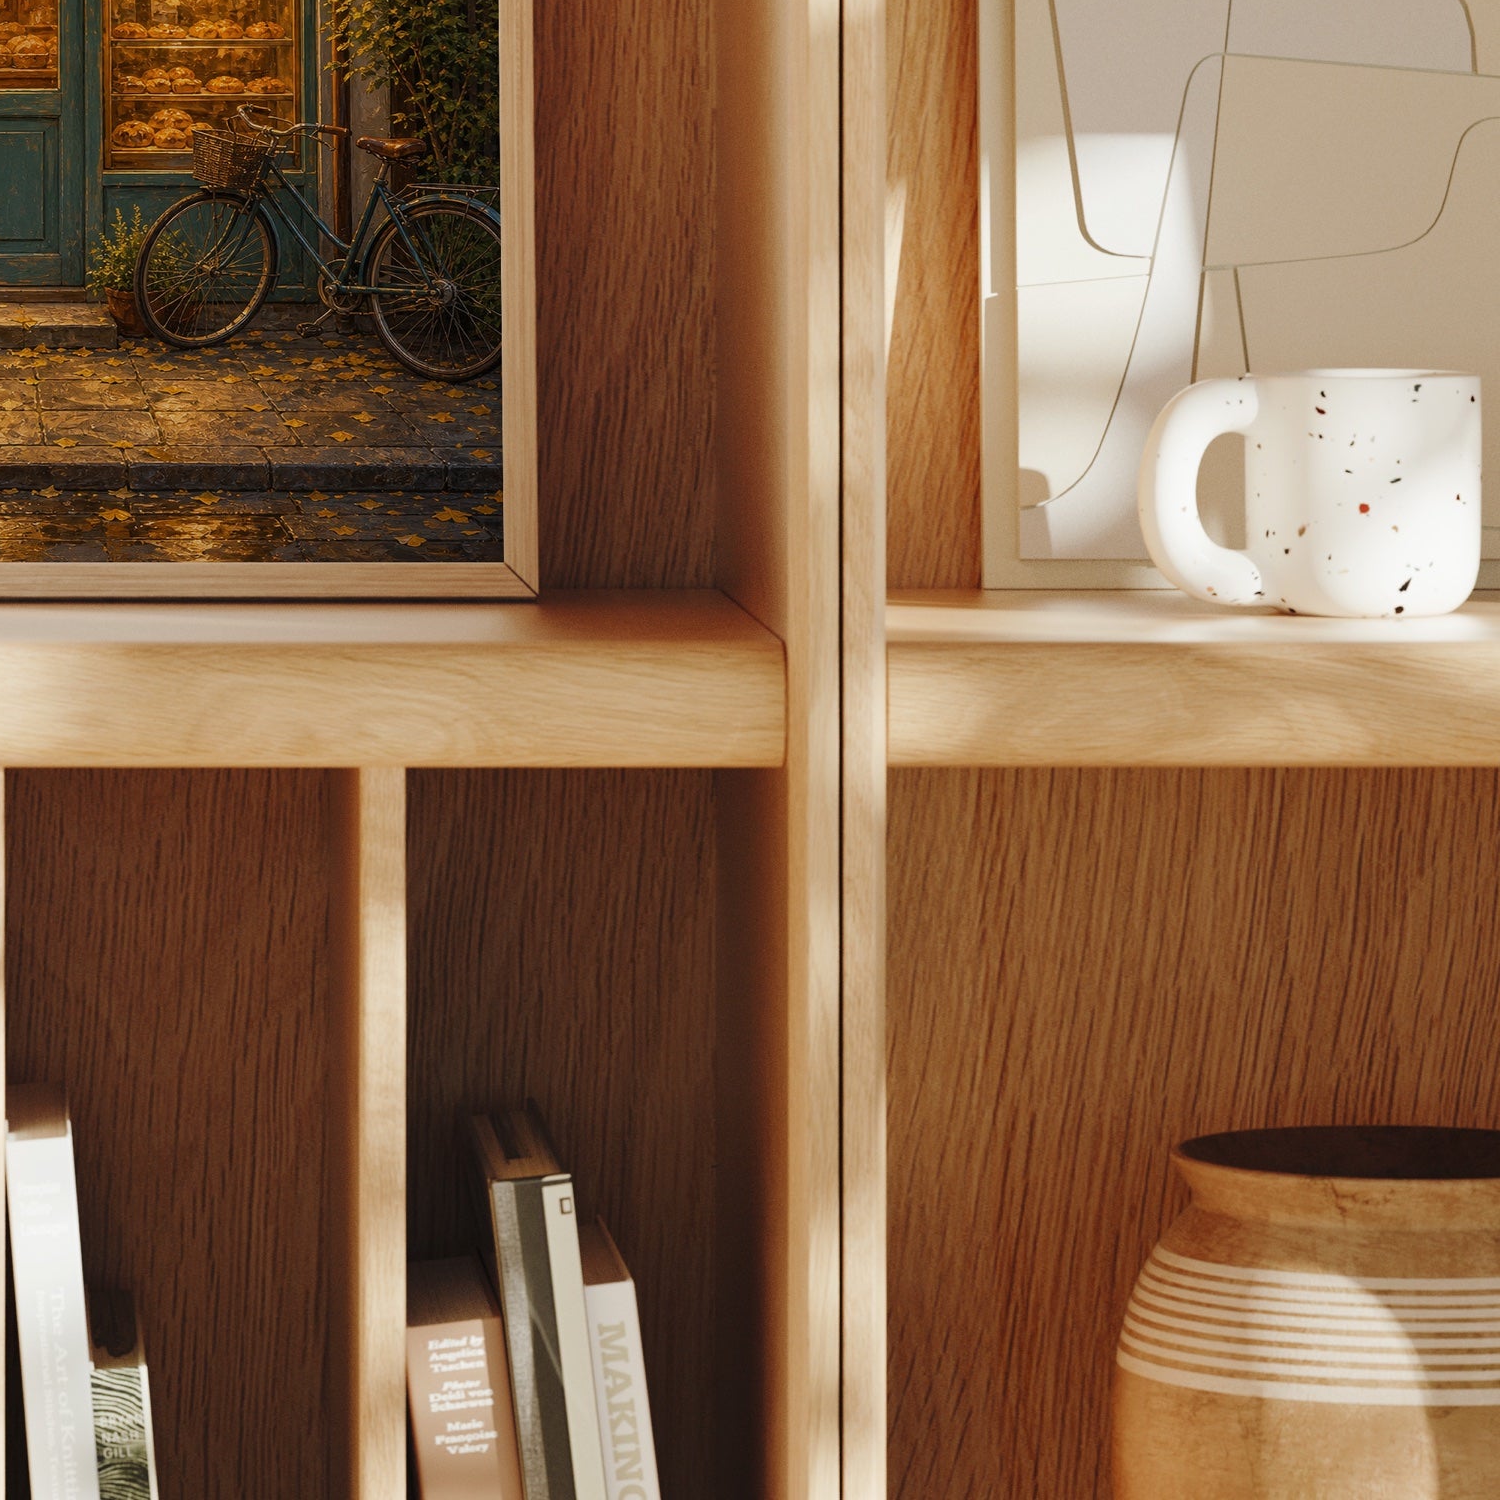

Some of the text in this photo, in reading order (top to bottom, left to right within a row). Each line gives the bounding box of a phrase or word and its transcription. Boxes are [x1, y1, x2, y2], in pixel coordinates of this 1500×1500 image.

[50, 1286, 65, 1336] The
[470, 1335, 484, 1347] by
[55, 1342, 68, 1383] Art
[58, 1390, 73, 1415] of
[103, 1444, 133, 1459] GILL
